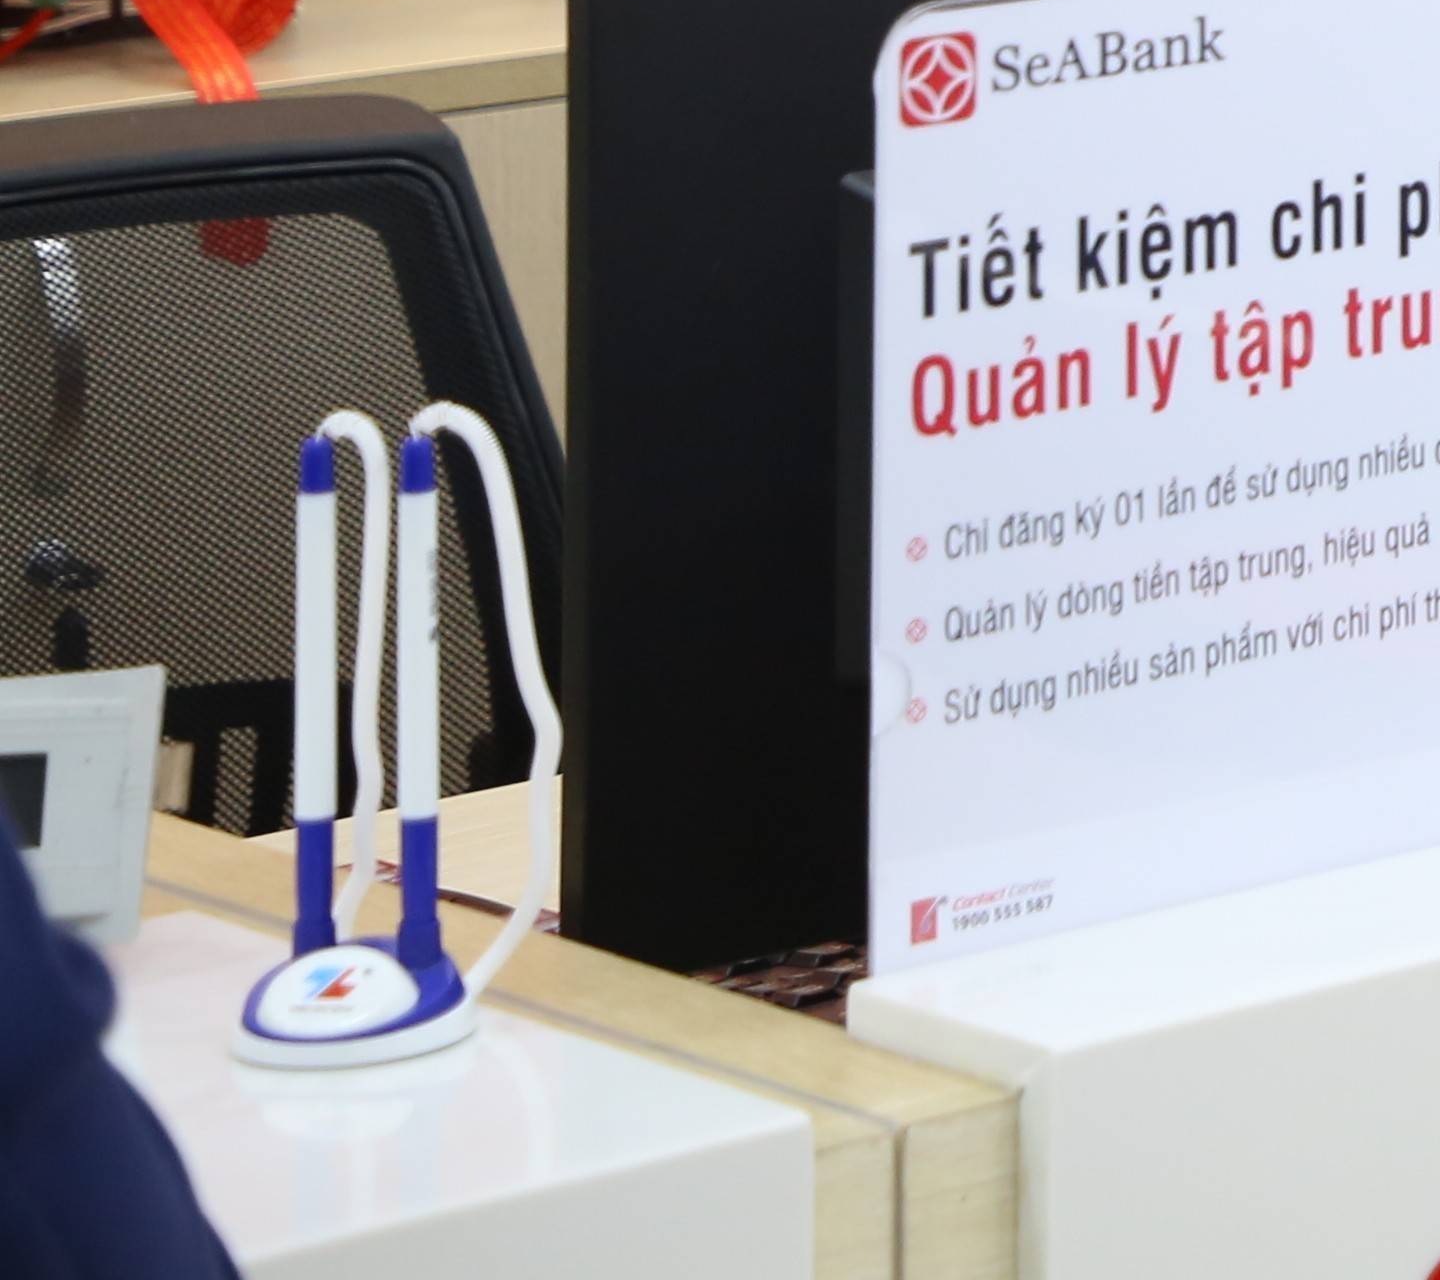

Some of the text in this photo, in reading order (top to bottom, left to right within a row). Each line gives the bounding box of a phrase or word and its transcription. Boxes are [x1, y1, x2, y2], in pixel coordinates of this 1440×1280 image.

[991, 16, 1225, 92] SeABank
[909, 213, 1043, 319] Tiết
[1077, 203, 1239, 301] kiệm
[1271, 172, 1367, 261] chi
[911, 335, 1091, 438] Quản
[1125, 314, 1183, 413] lý
[1211, 300, 1314, 397] tập
[999, 510, 1064, 547] đăng
[1075, 496, 1105, 540] ký
[1114, 489, 1145, 526] 01
[1246, 461, 1279, 502] sử
[1286, 457, 1350, 497] dụng
[1358, 432, 1426, 481] nhiều
[944, 511, 1430, 643] Quản lý dòng tiền tập trung, hiệu quả
[944, 683, 980, 724] Sử
[990, 675, 1057, 719] dụng
[1066, 647, 1140, 700] nhiều
[1149, 642, 1195, 682] sản
[1205, 620, 1278, 678] phẩm
[1286, 610, 1323, 652] với
[1333, 601, 1371, 642] chi
[1379, 590, 1418, 641] phí
[952, 885, 1008, 911] Contact
[952, 894, 1055, 931] 1900 555 587
